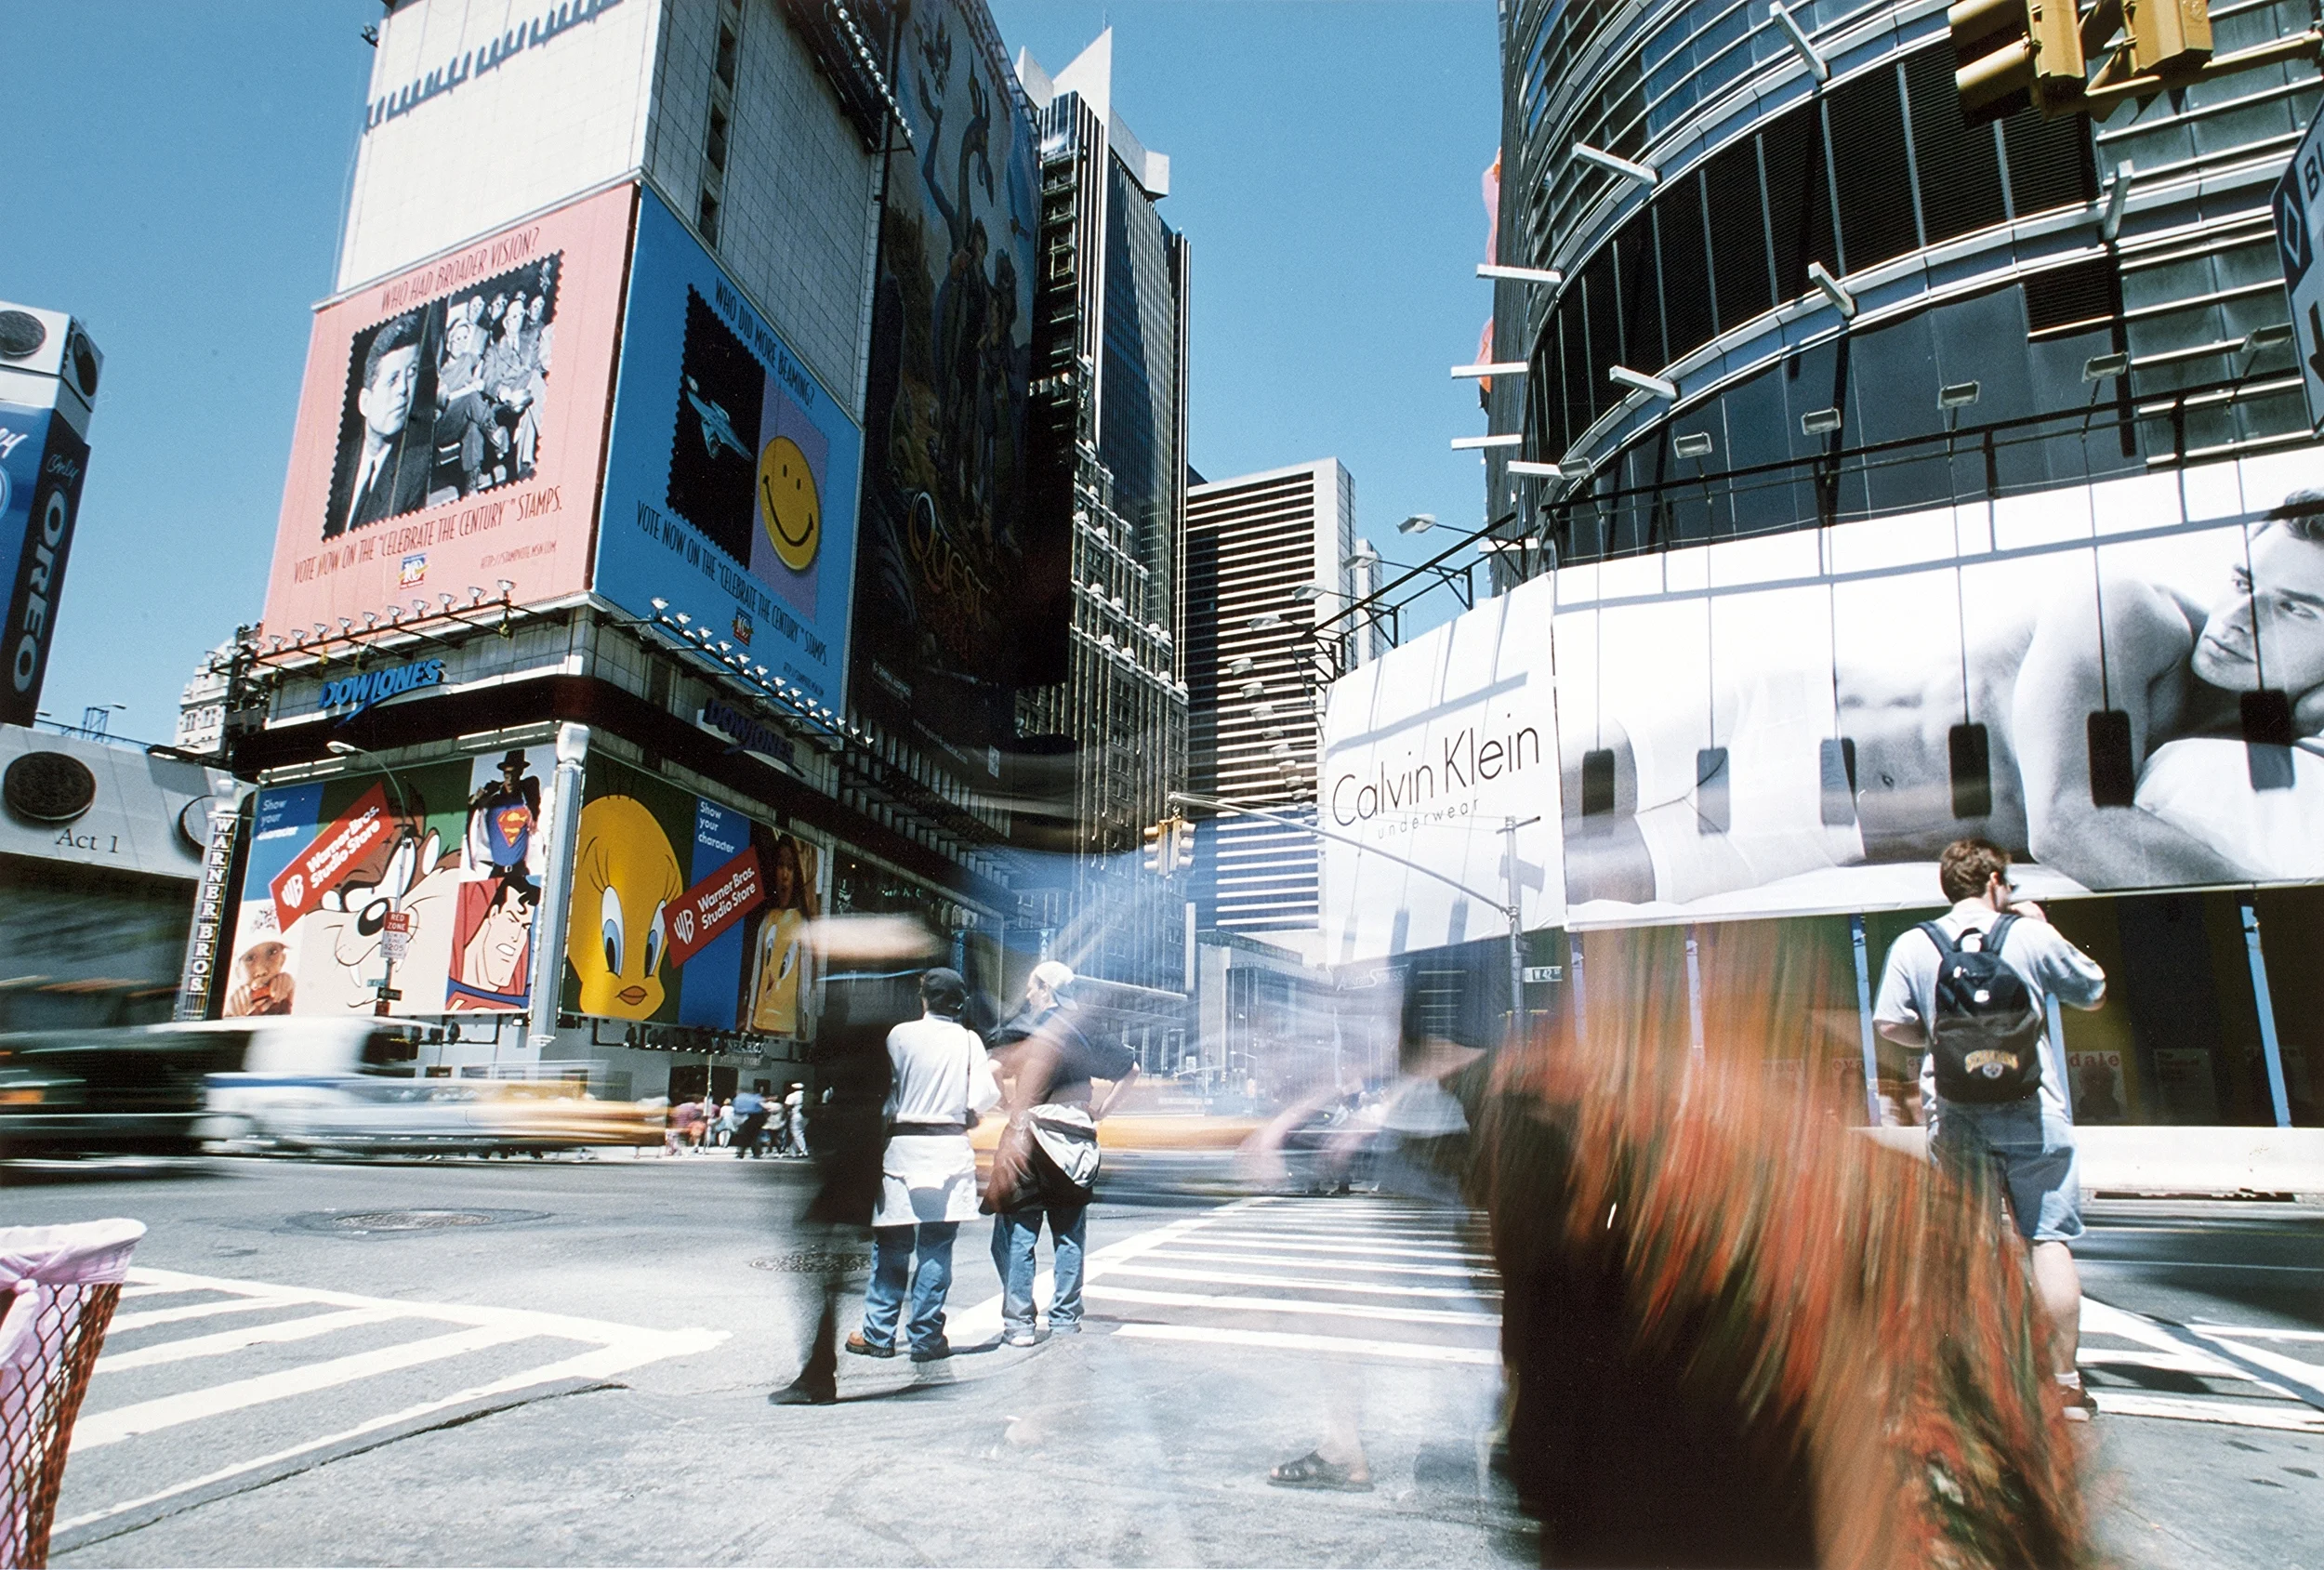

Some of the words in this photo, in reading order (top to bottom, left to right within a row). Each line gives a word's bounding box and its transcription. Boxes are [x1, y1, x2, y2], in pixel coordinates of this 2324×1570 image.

[381, 281, 408, 312] WHO
[411, 271, 433, 299] HAD
[435, 248, 487, 291] BROADER
[491, 227, 540, 268] VISION?
[716, 277, 737, 321] WHO
[738, 305, 753, 339] DID
[754, 324, 777, 368] MORE
[778, 350, 815, 409] BEAMING?
[295, 557, 317, 584] VOTE
[317, 549, 341, 577] NOW
[342, 543, 356, 568] ON
[359, 536, 376, 563] THE
[438, 514, 457, 543] THE
[516, 485, 561, 521] STAMPS.
[637, 500, 661, 540] VOTE
[662, 520, 686, 556] NOW
[687, 538, 700, 568] ON
[702, 548, 717, 581] THE
[758, 592, 771, 623] THE
[13, 489, 67, 693] OREO
[1332, 751, 1433, 826] Calvin
[1444, 713, 1539, 794] Klein
[260, 813, 283, 826] your
[262, 799, 287, 811] Show
[699, 801, 721, 819] Show
[699, 817, 719, 832] your
[1378, 798, 1480, 839] underwear
[56, 828, 98, 851] Act
[307, 827, 350, 873] Warner
[348, 806, 380, 835] Bros.
[310, 850, 349, 889] Studio
[347, 820, 381, 854] Store
[698, 831, 735, 853] character
[201, 819, 232, 917] WARNER
[697, 881, 733, 913] Warner
[732, 866, 756, 889] Bros.
[387, 922, 406, 930] ZONE
[390, 914, 404, 922] RED
[673, 909, 694, 945] WB
[701, 900, 733, 930] Studio
[732, 882, 756, 907] Store
[1534, 970, 1541, 980] W
[1542, 969, 1552, 980] 42
